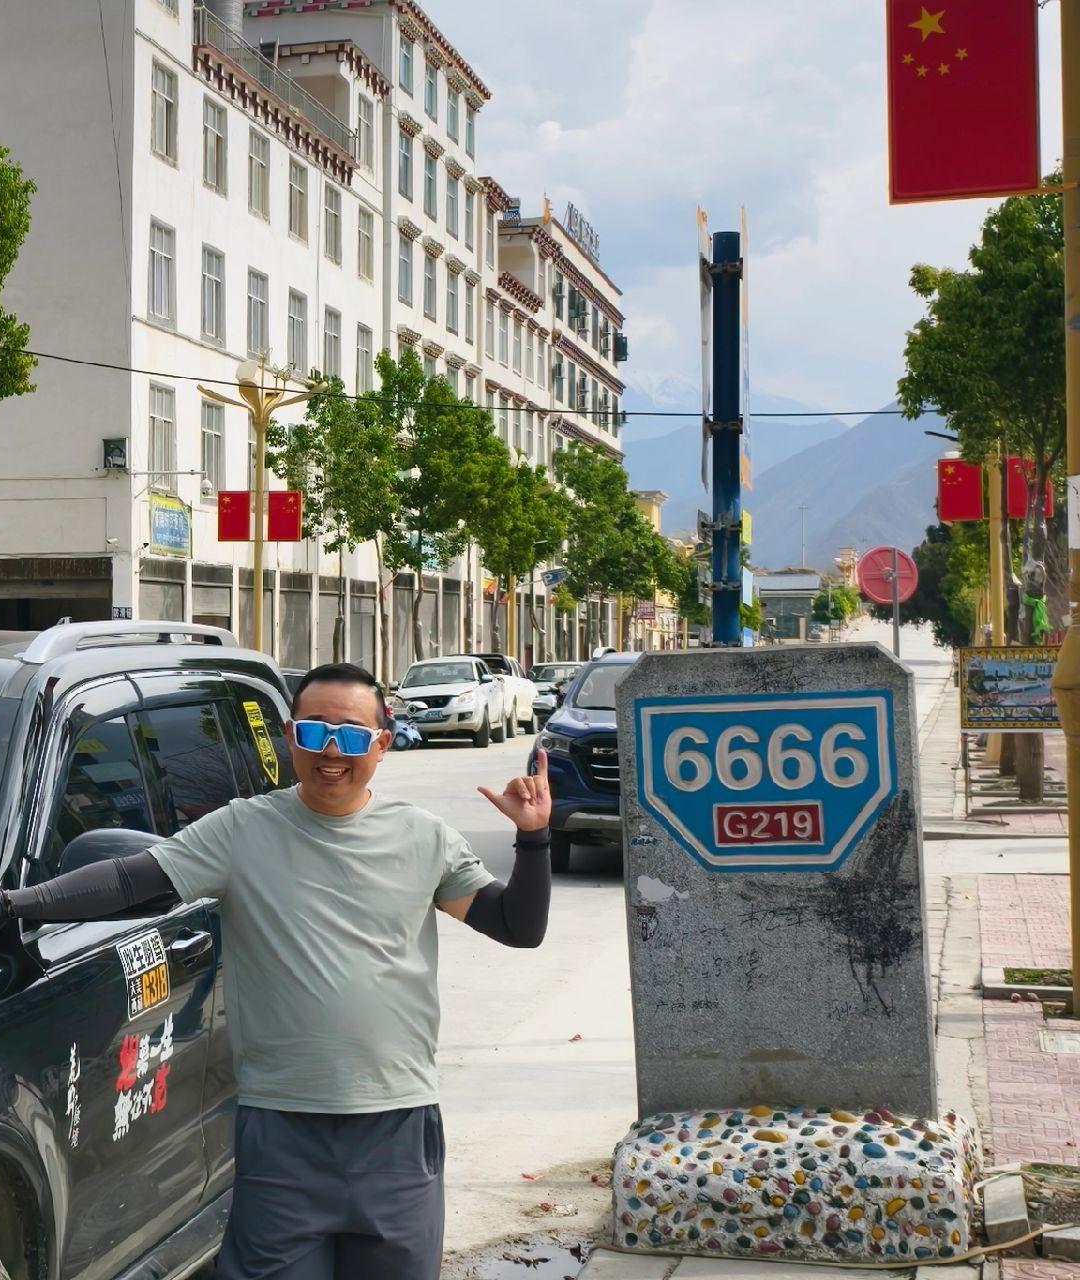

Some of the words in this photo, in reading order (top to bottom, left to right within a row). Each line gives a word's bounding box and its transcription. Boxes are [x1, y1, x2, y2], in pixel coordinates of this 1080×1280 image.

[664, 723, 869, 792] 6666
[723, 811, 813, 840] G219
[142, 963, 168, 1009] G318
